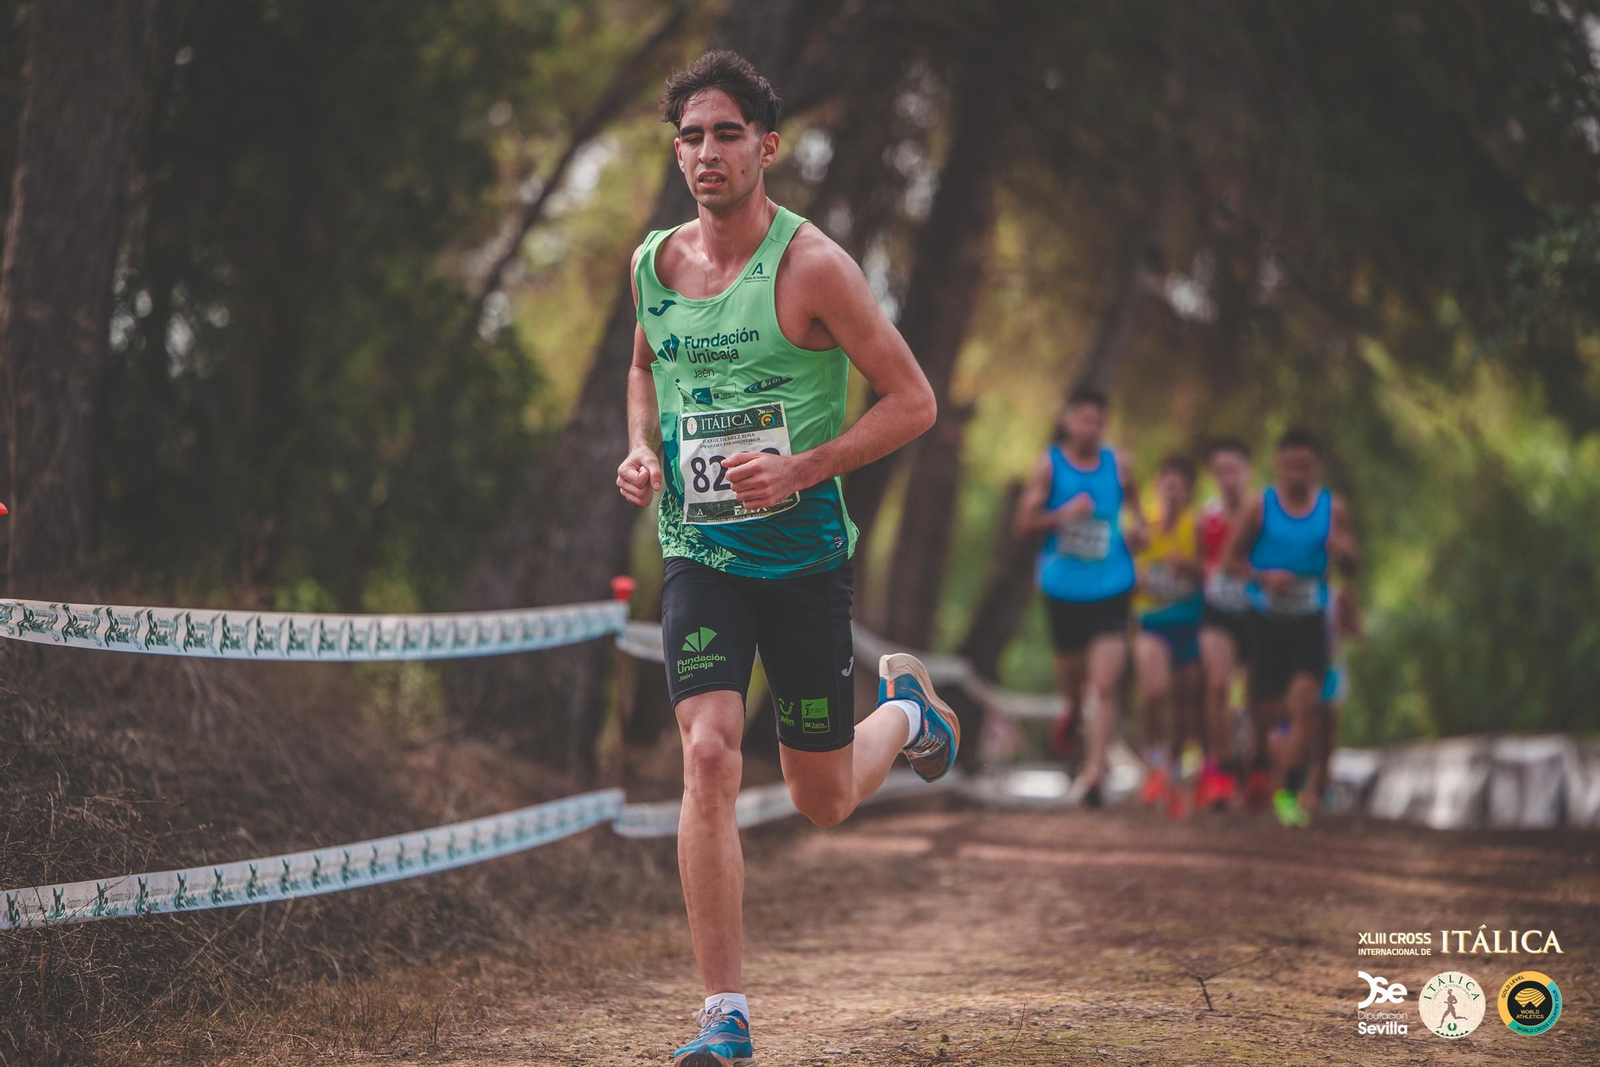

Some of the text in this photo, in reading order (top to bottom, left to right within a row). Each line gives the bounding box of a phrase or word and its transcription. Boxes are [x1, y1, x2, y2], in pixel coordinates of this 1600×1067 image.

[684, 328, 760, 349] Fundación
[687, 346, 740, 364] Unicaja
[693, 368, 715, 378] Jaén
[701, 413, 752, 430] ITÁLICA
[677, 653, 727, 668] Fundación
[677, 661, 714, 674] Unicaja
